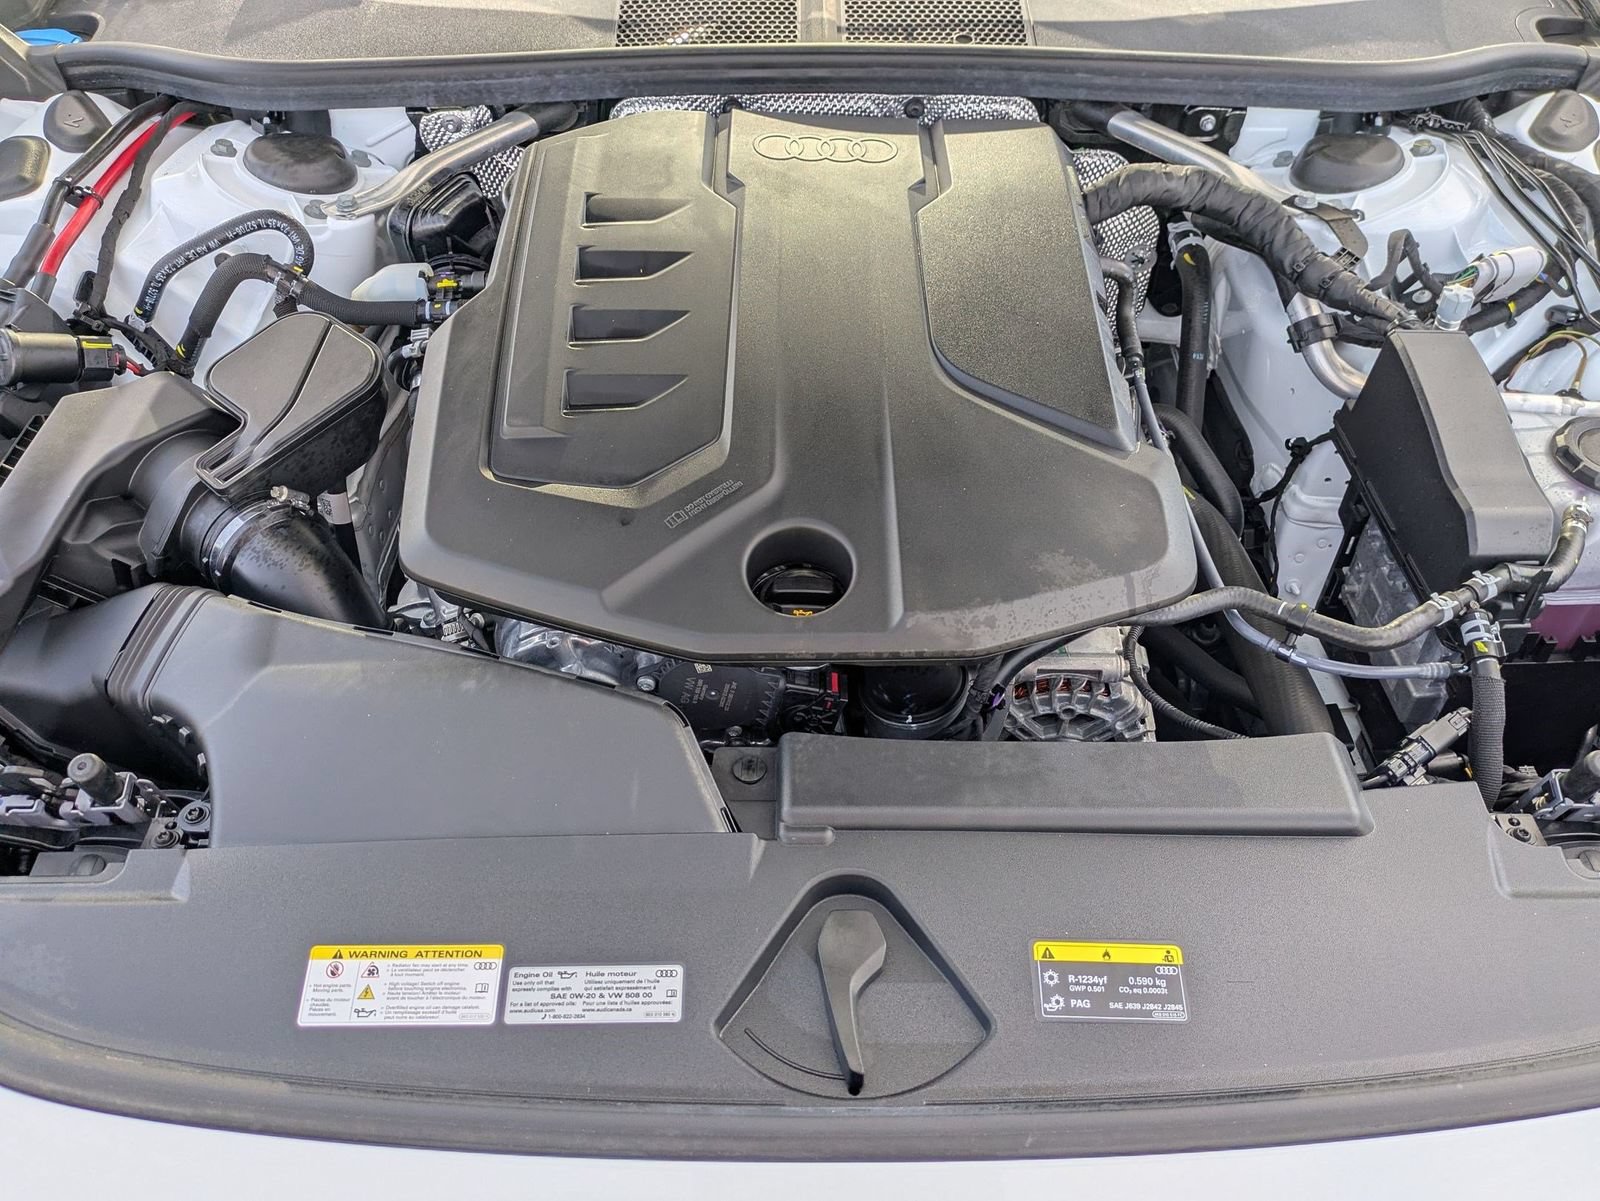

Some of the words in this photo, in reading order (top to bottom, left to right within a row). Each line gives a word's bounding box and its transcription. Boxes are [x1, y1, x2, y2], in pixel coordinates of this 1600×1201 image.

[226, 220, 258, 240] 52706-H
[289, 230, 302, 243] VRT
[197, 244, 208, 255] AG
[208, 239, 221, 250] VW
[295, 244, 305, 255] DE
[186, 250, 199, 261] DE
[684, 677, 696, 690] VW
[680, 692, 690, 704] AG
[348, 950, 408, 958] WARNING
[414, 950, 483, 958] ATTENTION
[1068, 975, 1107, 985] R-1234yf
[1129, 977, 1153, 985] 0.590
[1155, 977, 1166, 987] kg
[1071, 1000, 1091, 1008] PAG
